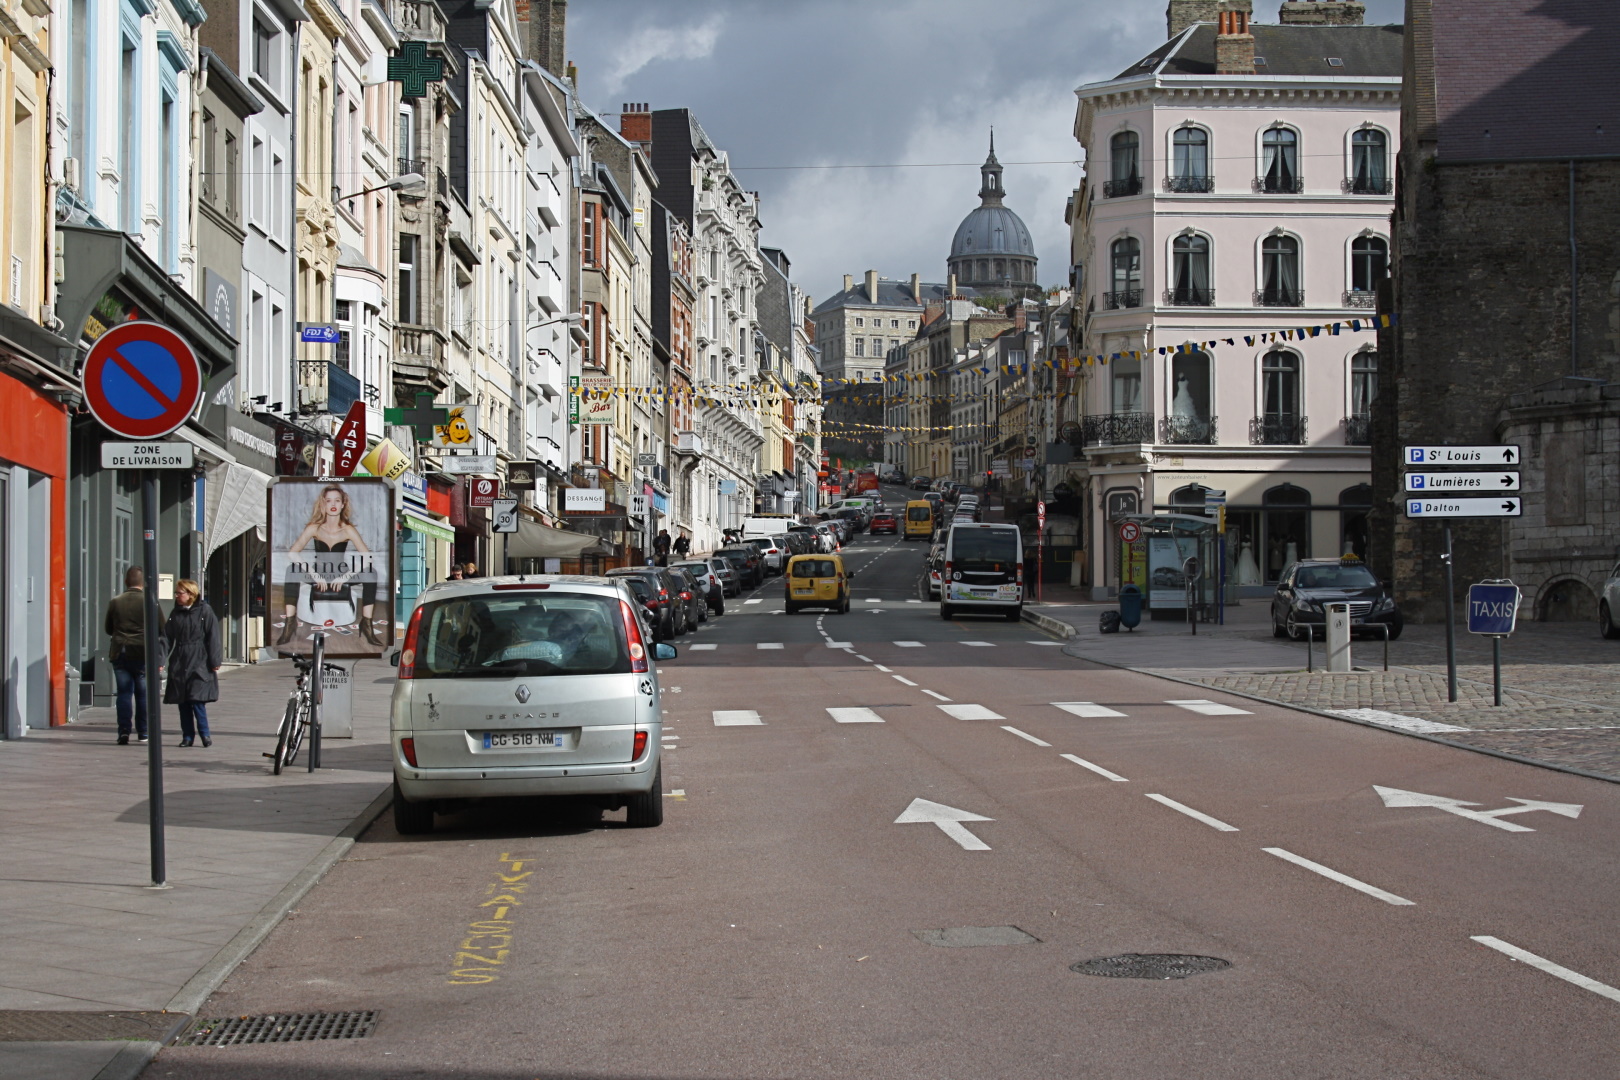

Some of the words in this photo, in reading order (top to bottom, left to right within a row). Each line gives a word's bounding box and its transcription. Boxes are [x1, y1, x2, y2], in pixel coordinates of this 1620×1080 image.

[590, 402, 611, 413] Bar
[341, 420, 359, 468] TABAC
[134, 446, 160, 454] ZONE
[1413, 450, 1421, 460] P
[1447, 450, 1481, 461] Louis
[112, 456, 126, 465] DE
[128, 456, 182, 465] LIVRAISON
[1414, 477, 1422, 487] P
[1430, 476, 1481, 487] Lumières
[1413, 504, 1420, 512] P
[1425, 503, 1460, 512] Dalton
[500, 516, 510, 524] 30
[290, 555, 374, 574] minelli
[1472, 600, 1514, 618] TAXIS
[486, 712, 560, 720] ESPACE
[491, 732, 554, 746] CG-518-NM
